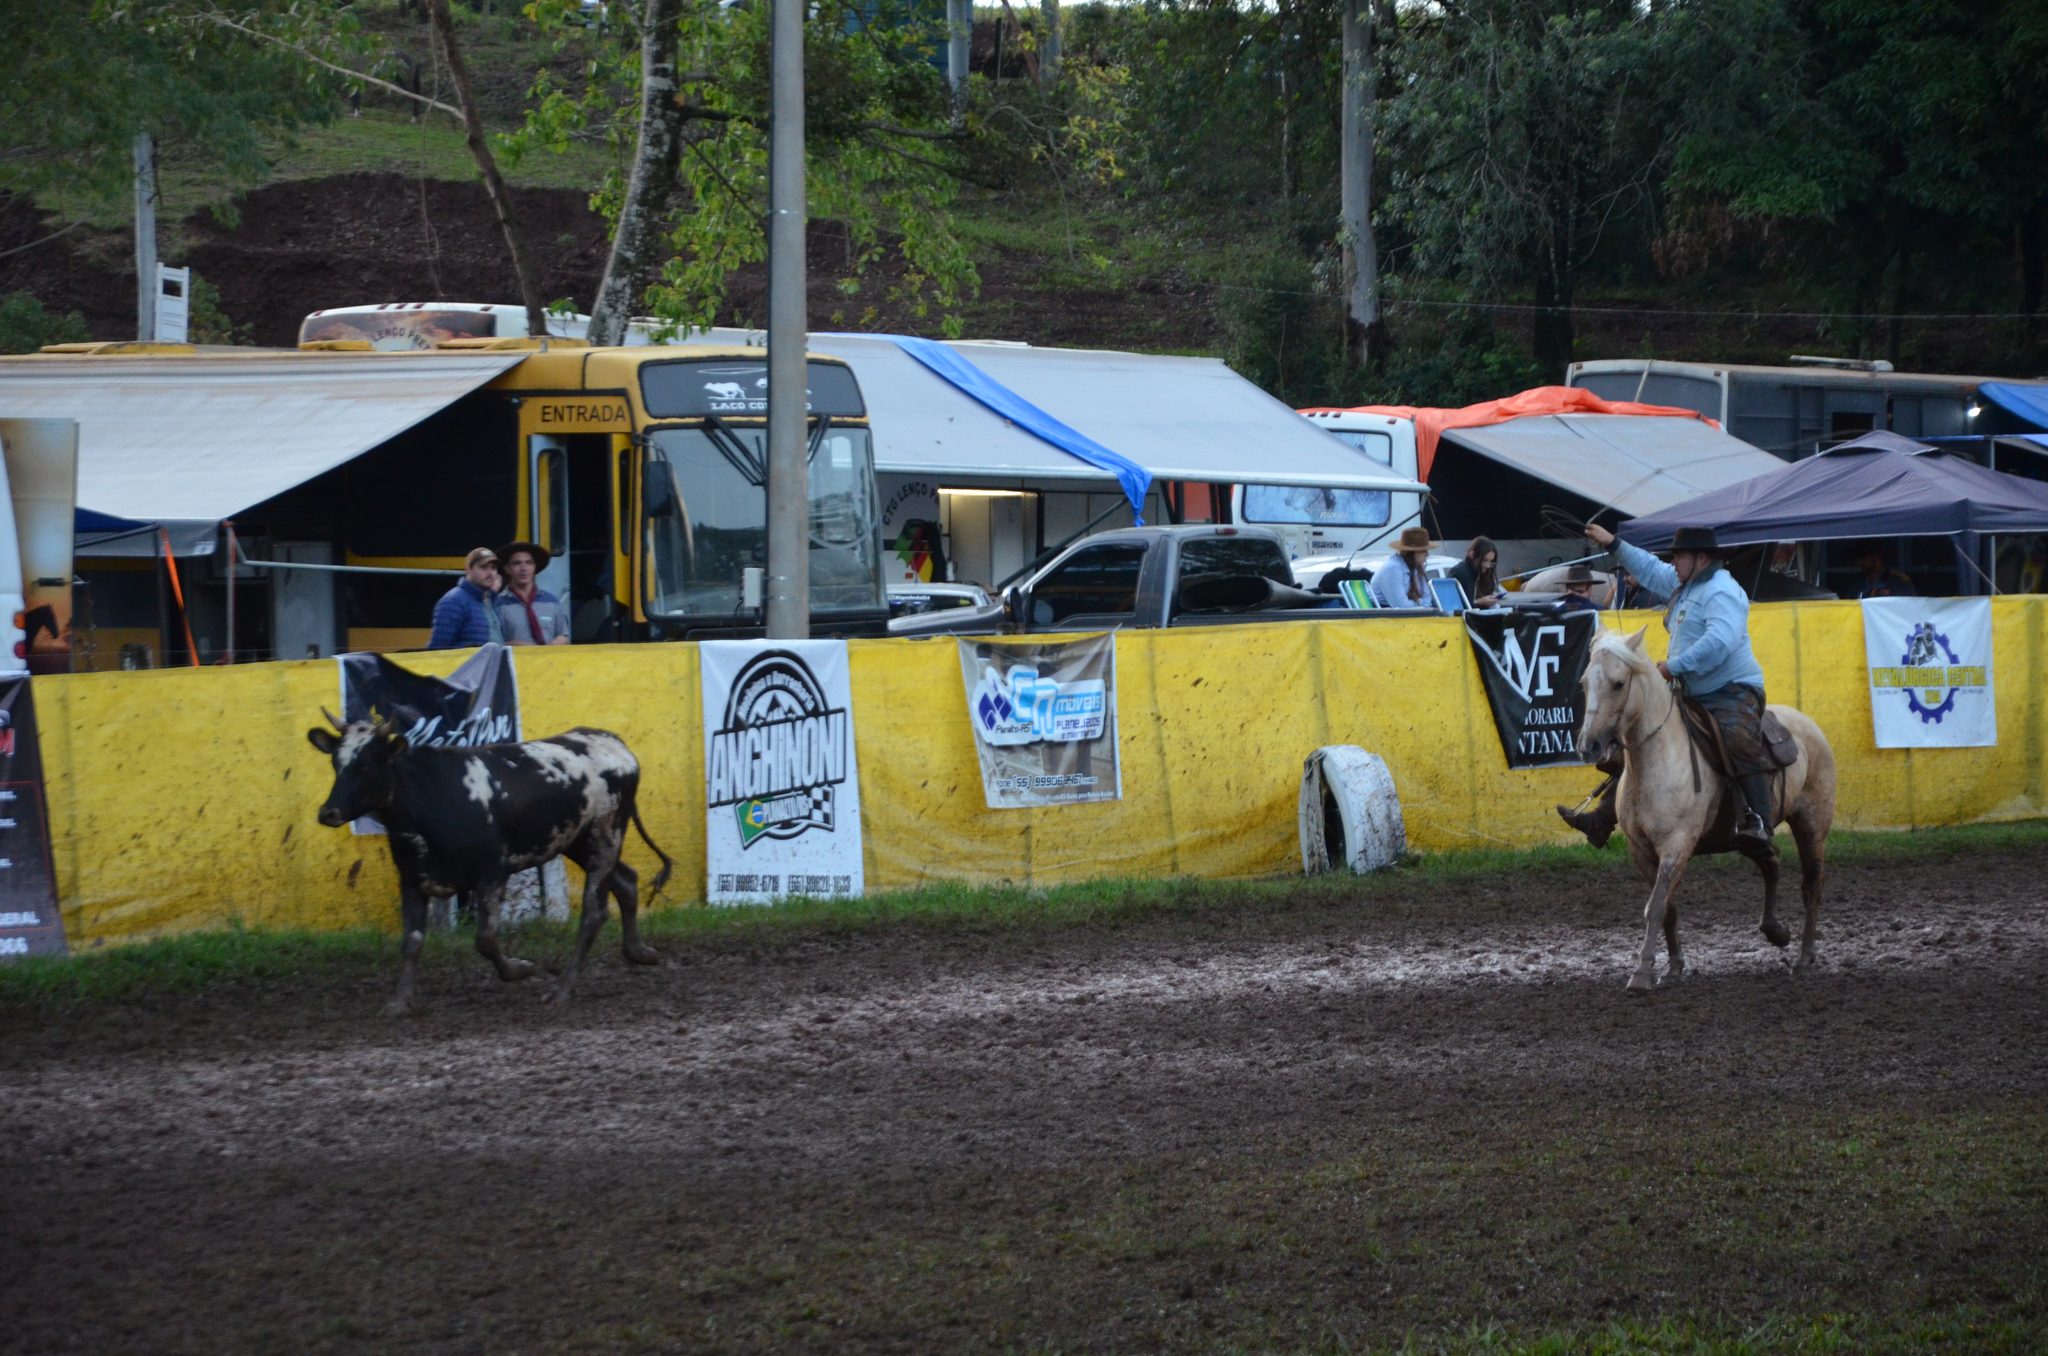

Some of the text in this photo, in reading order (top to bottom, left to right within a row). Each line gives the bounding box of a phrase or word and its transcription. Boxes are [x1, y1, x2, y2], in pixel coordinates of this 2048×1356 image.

[541, 405, 626, 422] ENTRADA
[883, 498, 898, 525] CTG
[709, 710, 846, 807] ANGHINONI
